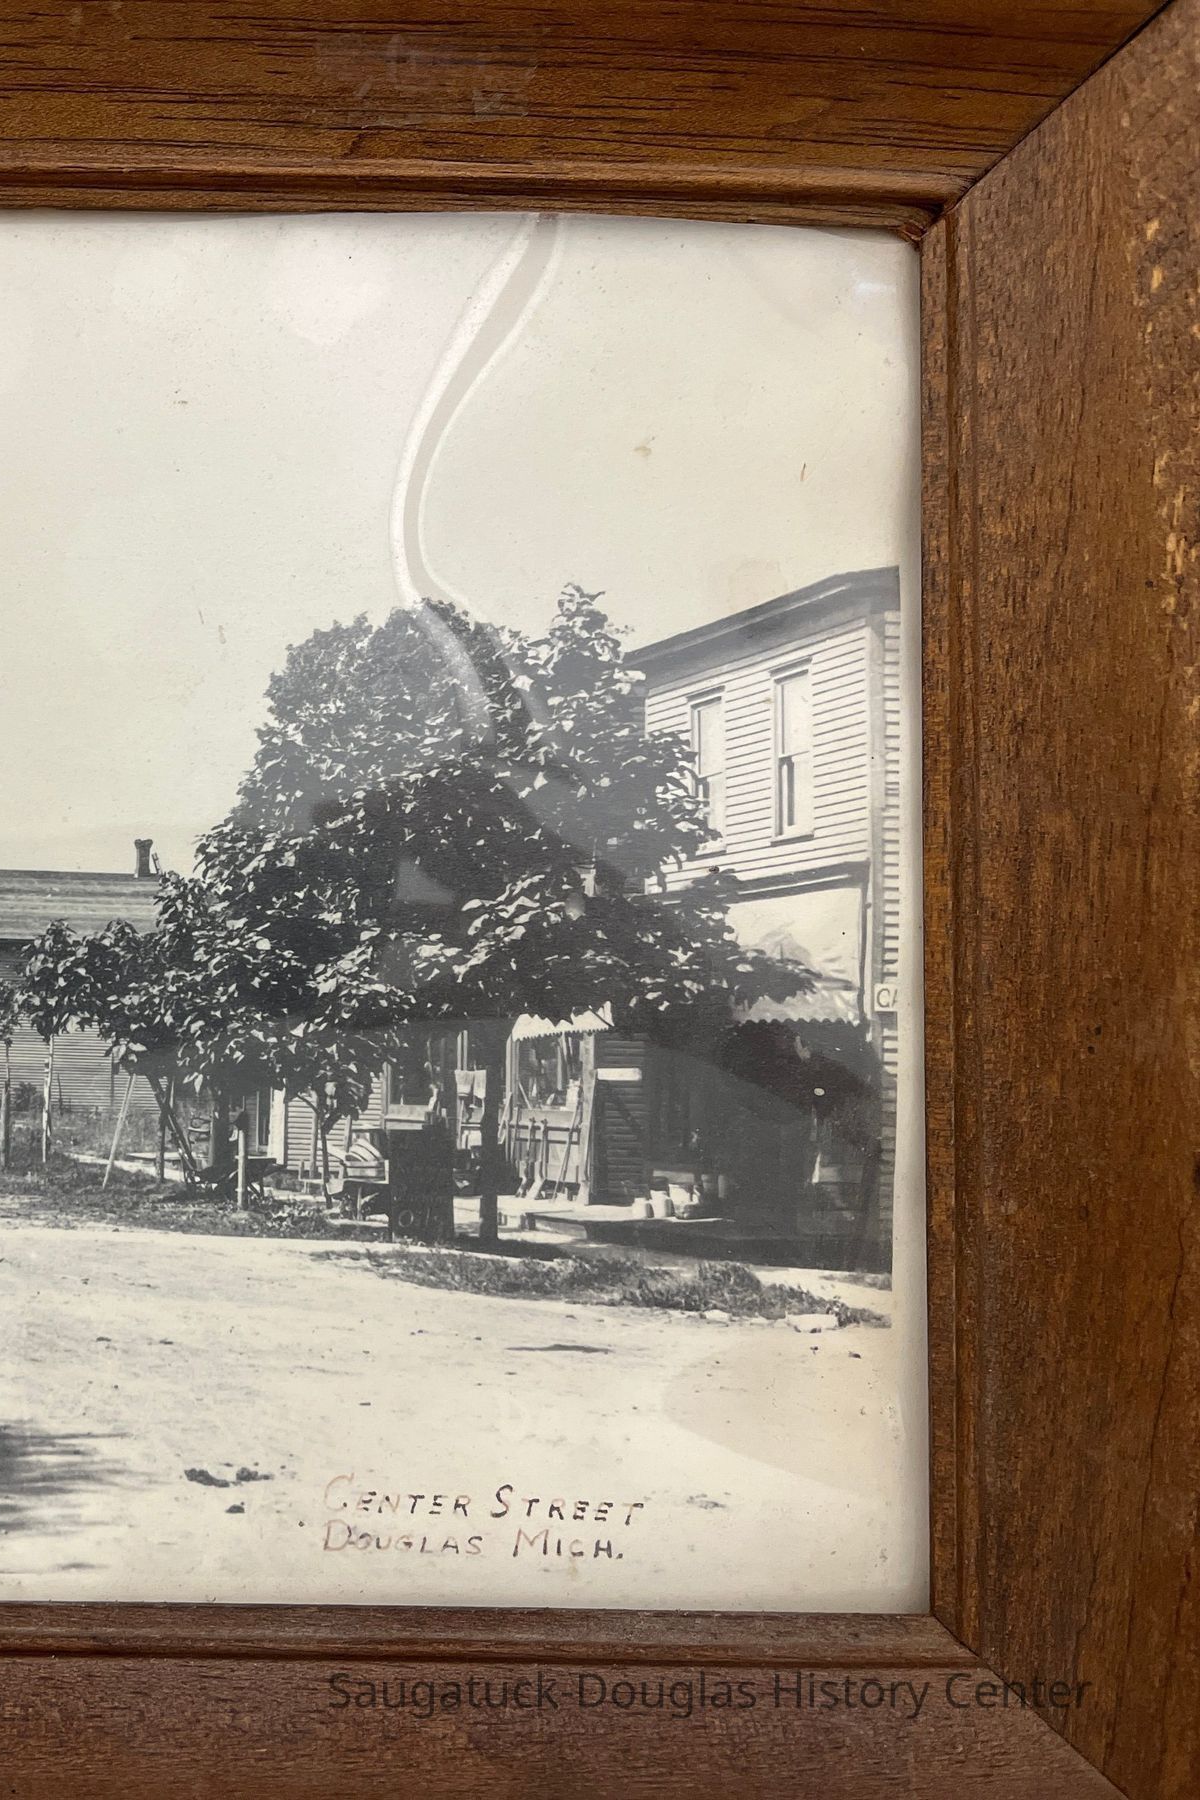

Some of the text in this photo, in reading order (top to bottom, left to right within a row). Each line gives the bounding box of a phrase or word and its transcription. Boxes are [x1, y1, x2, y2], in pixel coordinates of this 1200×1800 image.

[324, 1473, 644, 1526] CENTER STREET
[323, 1518, 624, 1559] DOUGLAS MICH.
